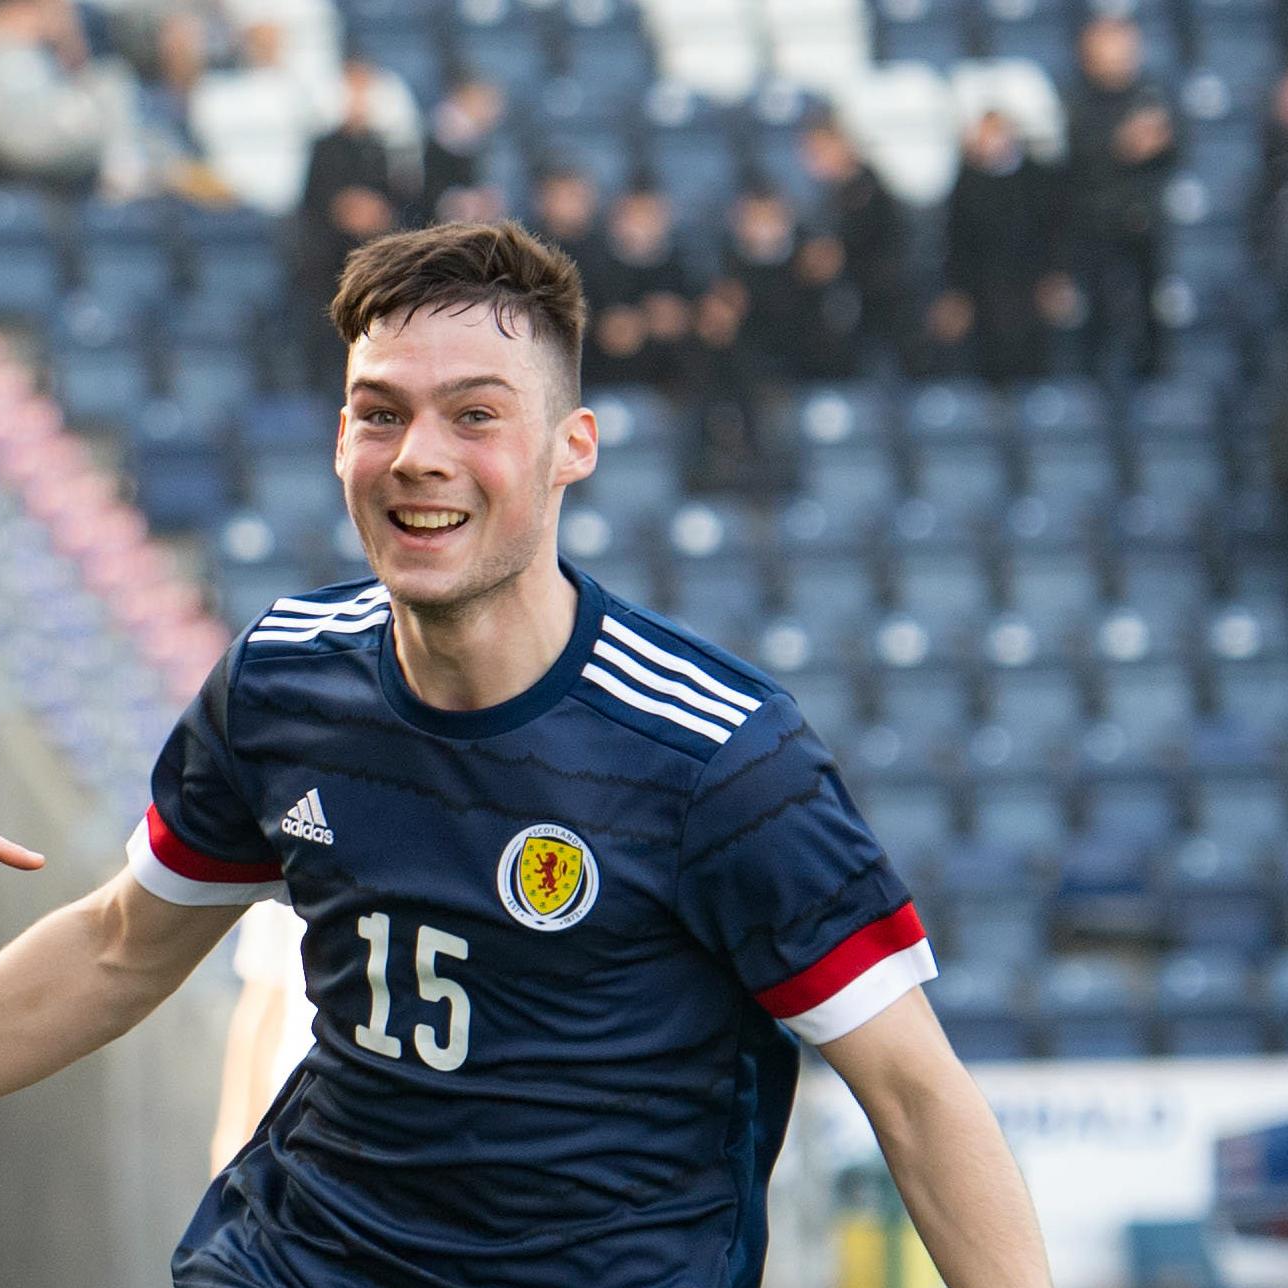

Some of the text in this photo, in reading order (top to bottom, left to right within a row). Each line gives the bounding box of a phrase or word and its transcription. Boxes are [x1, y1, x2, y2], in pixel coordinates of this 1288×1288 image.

[281, 817, 334, 845] adidas
[532, 827, 579, 845] SCOTLAND
[355, 911, 472, 1073] 15
